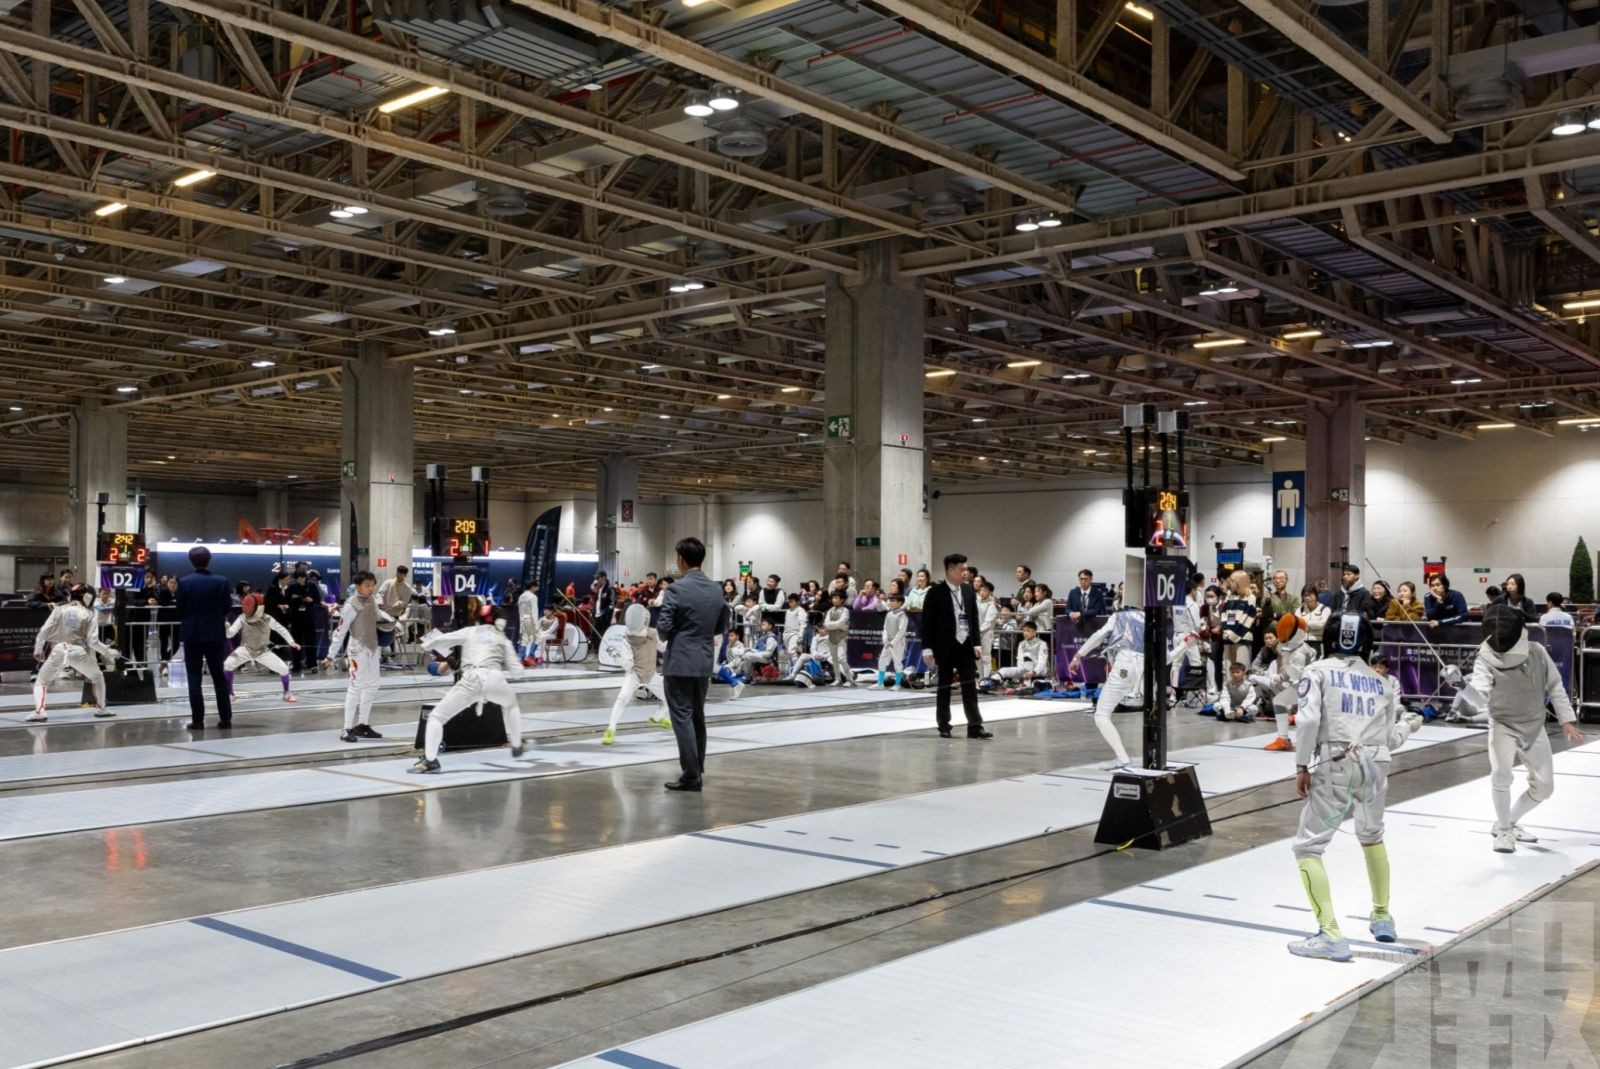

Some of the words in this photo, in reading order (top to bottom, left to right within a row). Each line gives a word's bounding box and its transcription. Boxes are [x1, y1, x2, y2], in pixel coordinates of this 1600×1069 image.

[454, 520, 476, 534] 2:09
[114, 534, 134, 544] 2:42
[450, 538, 459, 556] 2
[109, 547, 118, 561] 2
[137, 548, 146, 562] 2
[113, 572, 133, 587] D2
[454, 573, 476, 593] D4
[1157, 573, 1176, 601] D6
[1349, 673, 1384, 696] WONG
[1341, 692, 1376, 717] MAC
